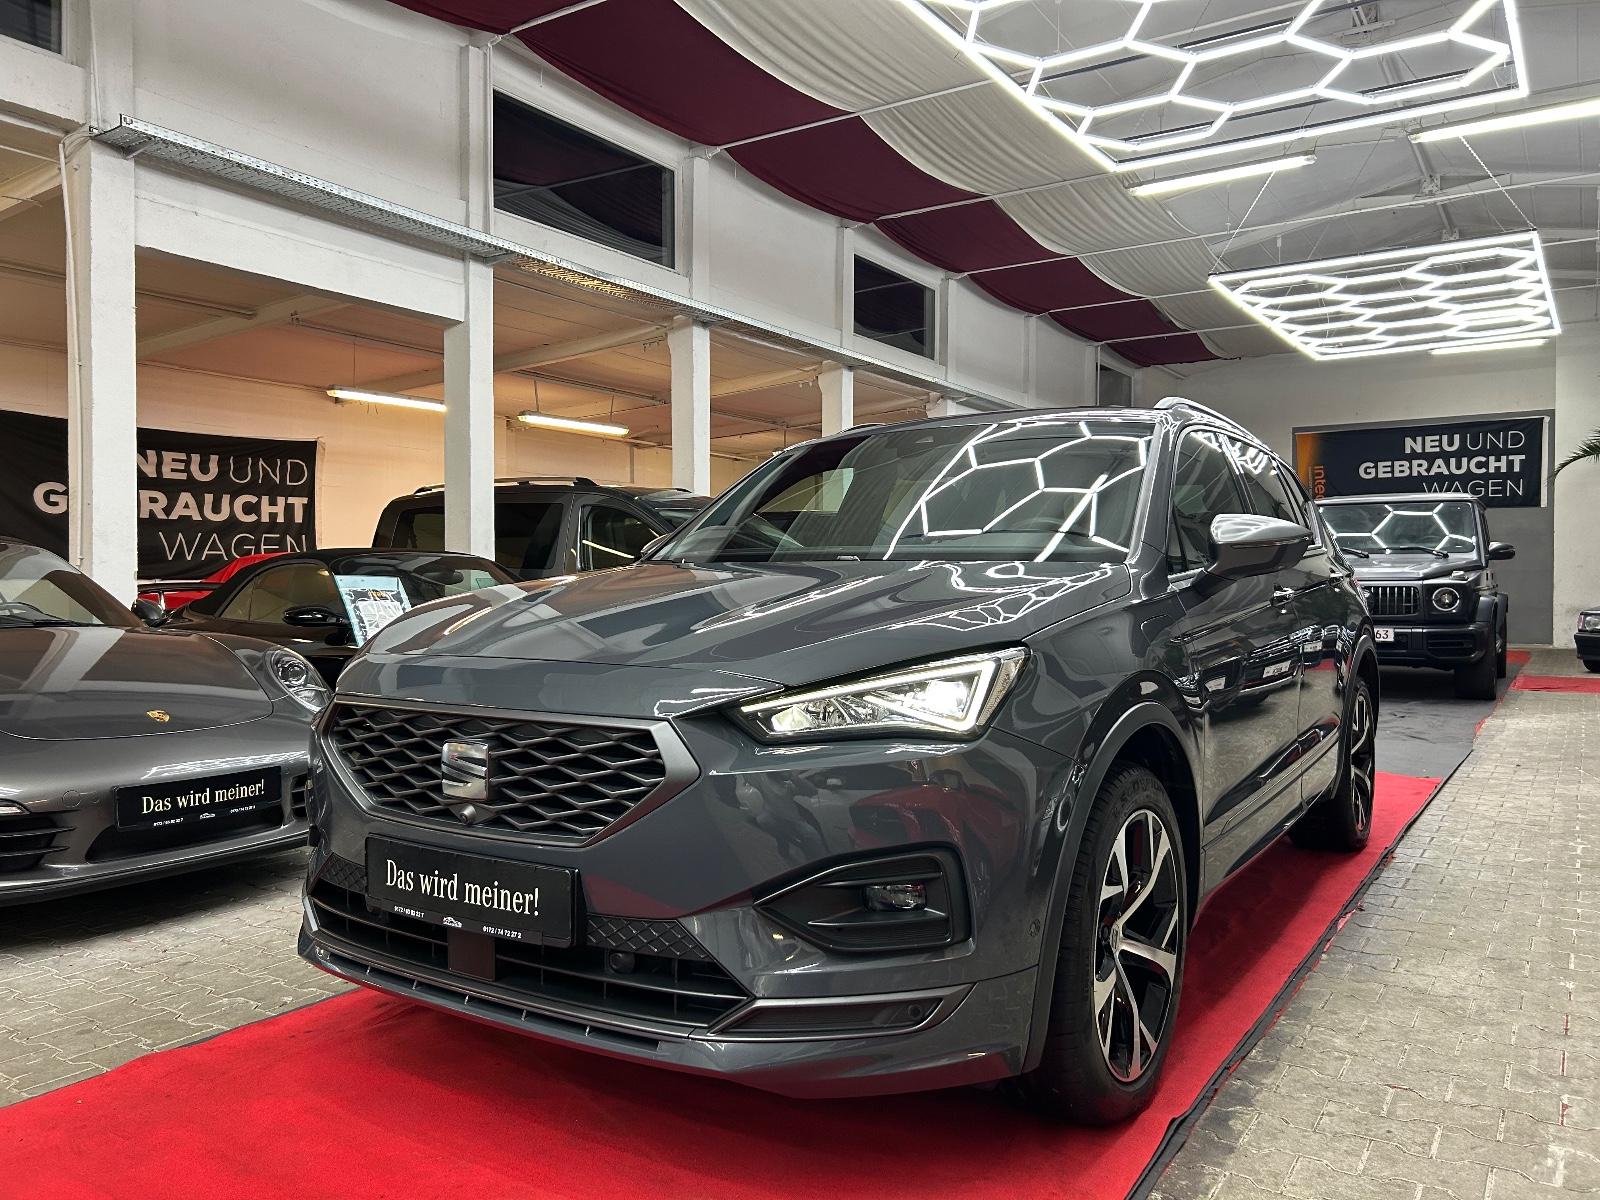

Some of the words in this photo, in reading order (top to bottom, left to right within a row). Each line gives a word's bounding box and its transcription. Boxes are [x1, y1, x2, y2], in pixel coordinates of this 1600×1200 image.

[1404, 433, 1460, 454] NEU
[1466, 430, 1525, 451] UND
[137, 449, 219, 482] NEU
[229, 456, 308, 486] UND
[1358, 454, 1526, 480] GEBRAUCHT
[33, 481, 309, 524] GRAUCHT
[1422, 478, 1523, 497] WAGEN
[158, 531, 307, 561] WAGEN
[1375, 629, 1389, 640] 63
[141, 796, 172, 814] Das
[175, 787, 211, 809] wird
[214, 778, 265, 803] meiner!
[386, 859, 414, 892] Das
[418, 869, 459, 901] wird
[463, 880, 539, 917] meiner!
